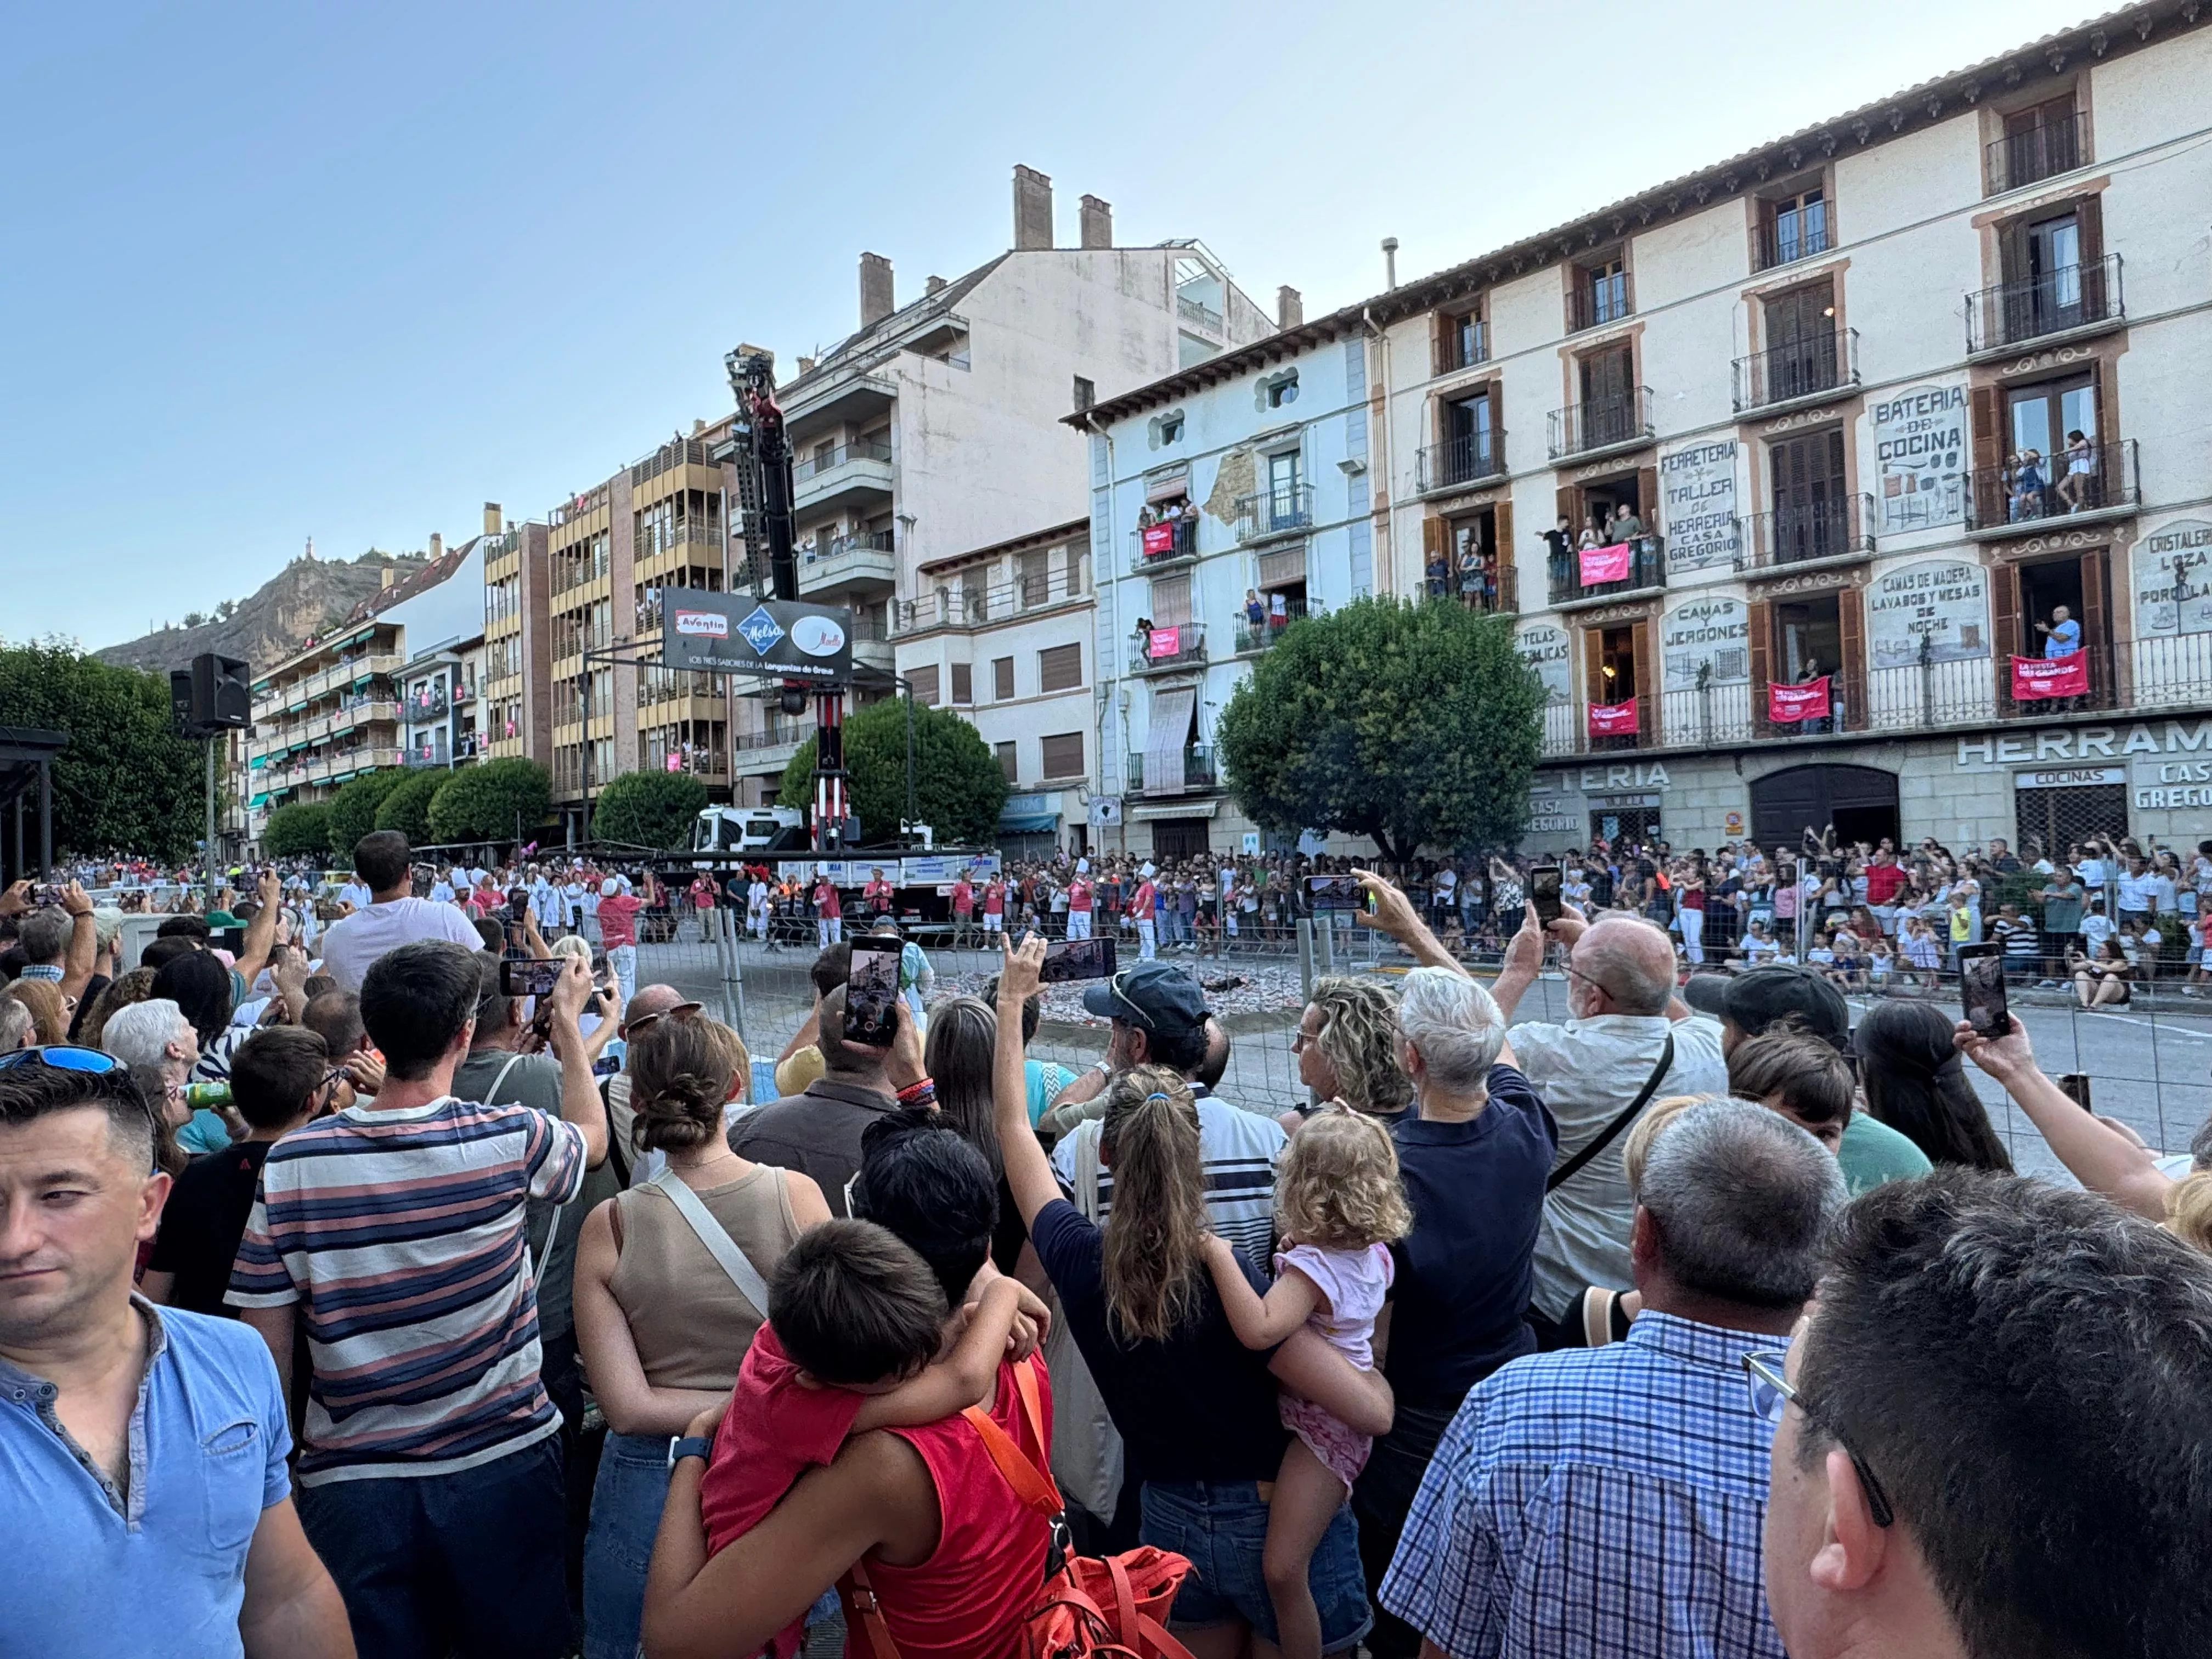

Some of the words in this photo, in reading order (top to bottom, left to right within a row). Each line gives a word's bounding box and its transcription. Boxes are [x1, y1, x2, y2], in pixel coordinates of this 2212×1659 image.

[1877, 387, 1963, 425] BATERIA
[1907, 418, 1931, 433] DE
[1878, 427, 1961, 461] COCINA
[1662, 442, 1736, 473] FERRETERIA
[1668, 478, 1732, 504] TALLER
[1691, 500, 1708, 514] DE
[1669, 510, 1733, 535] HERRERIA
[1681, 530, 1723, 545] CASA
[1670, 538, 1737, 560] GREGORIO
[2162, 551, 2208, 571] LOZA
[1883, 574, 1914, 592] CAMAS
[1917, 573, 1930, 588] DE
[1933, 567, 1972, 585] MADERA
[1872, 593, 1926, 611] LAVABOS
[1929, 591, 1936, 603] Y
[1939, 585, 1979, 601] MESAS
[1679, 603, 1734, 621] CAMAS
[1917, 606, 1935, 618] DE
[1667, 623, 1748, 646] JERGONES
[1908, 617, 1948, 634] NOCHE
[1523, 629, 1555, 646] TELAS
[755, 661, 763, 669] LA
[1957, 720, 2212, 765] HERRAM
[2035, 769, 2105, 785] COCINAS
[2160, 761, 2210, 783] CAS
[2135, 787, 2212, 808] GREGO
[1523, 816, 1579, 832] REGORIO
